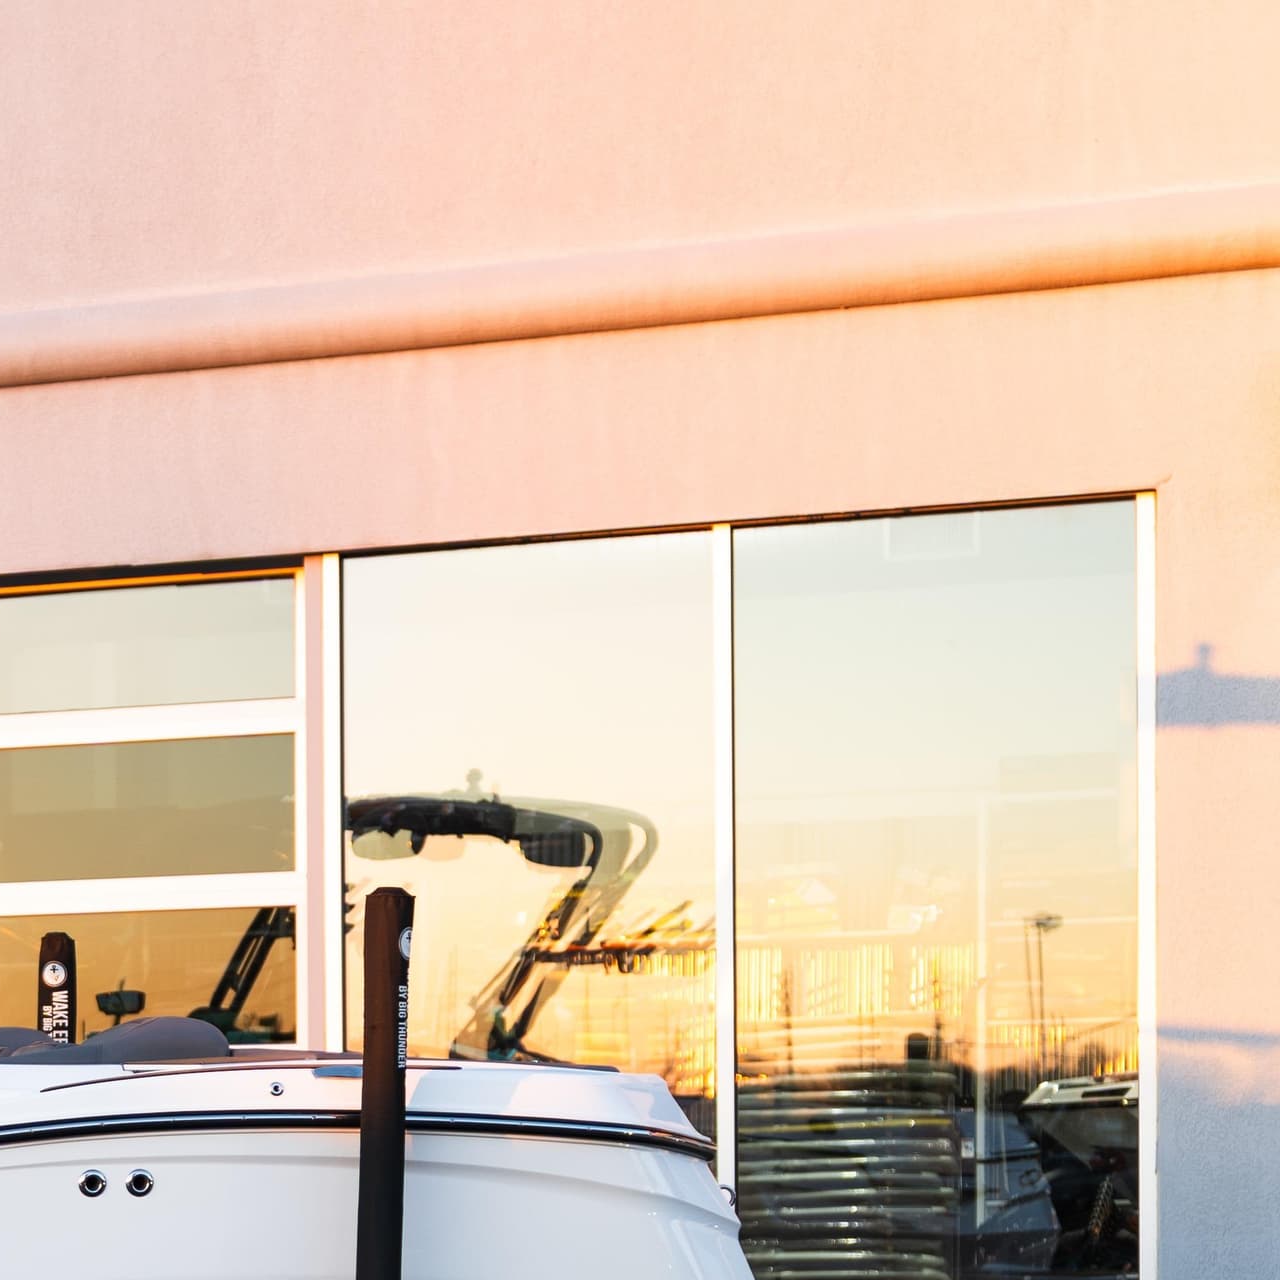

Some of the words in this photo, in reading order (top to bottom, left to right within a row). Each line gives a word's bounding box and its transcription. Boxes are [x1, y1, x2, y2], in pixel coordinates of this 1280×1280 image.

[398, 985, 408, 999] BY
[42, 1005, 53, 1017] BY
[52, 991, 69, 1027] WAKE
[398, 1001, 408, 1018] BIG
[42, 1017, 53, 1032] BIG
[397, 1021, 407, 1068] THUNDER
